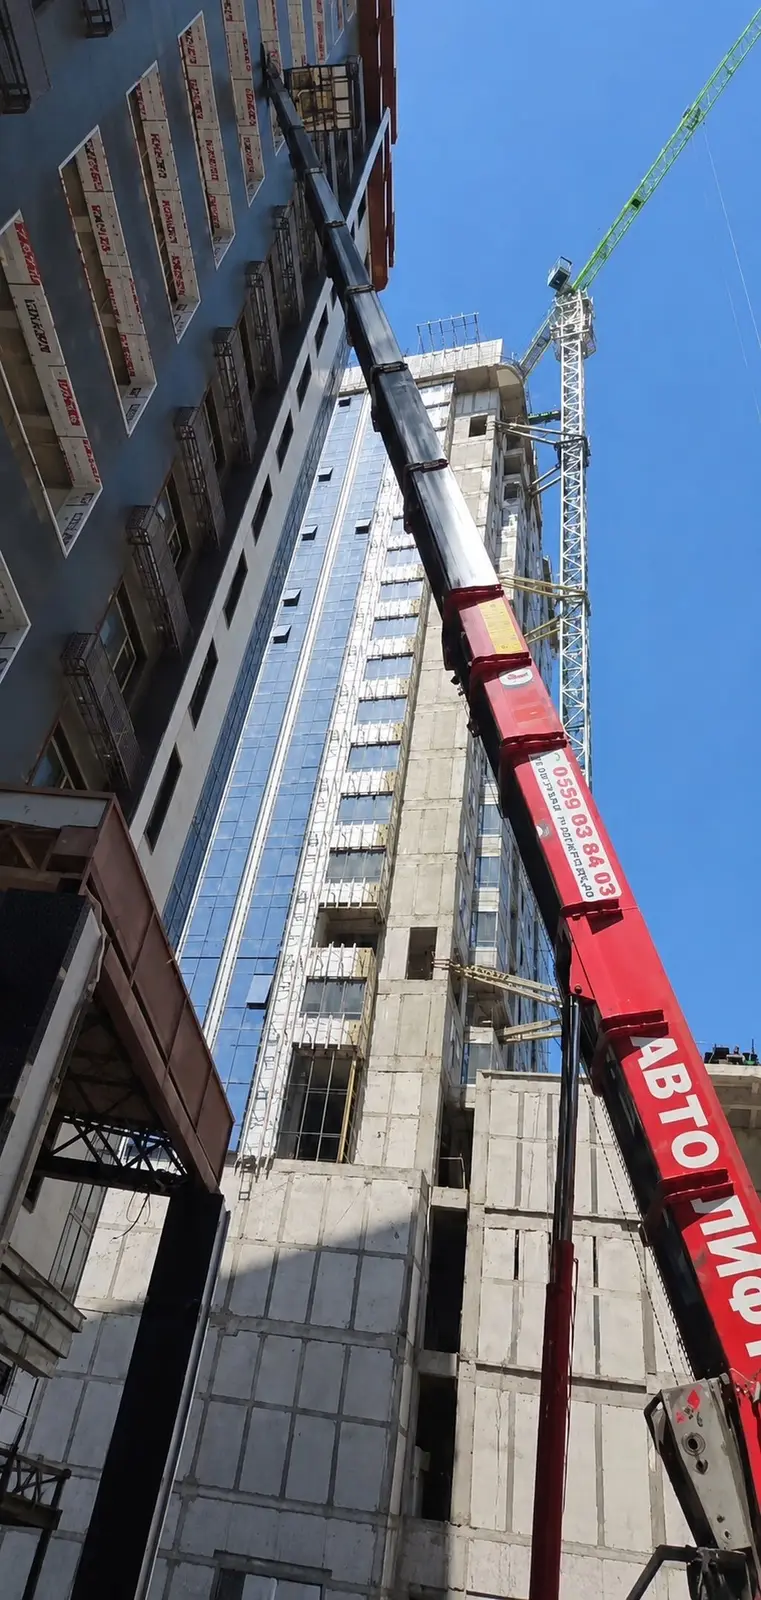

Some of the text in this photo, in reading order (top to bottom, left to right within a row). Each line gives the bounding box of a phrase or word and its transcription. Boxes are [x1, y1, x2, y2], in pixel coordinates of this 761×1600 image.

[553, 766, 581, 810] 0559
[571, 813, 593, 839] 03
[582, 843, 605, 868] 84
[594, 872, 616, 896] 03
[632, 1036, 720, 1169] АВТО
